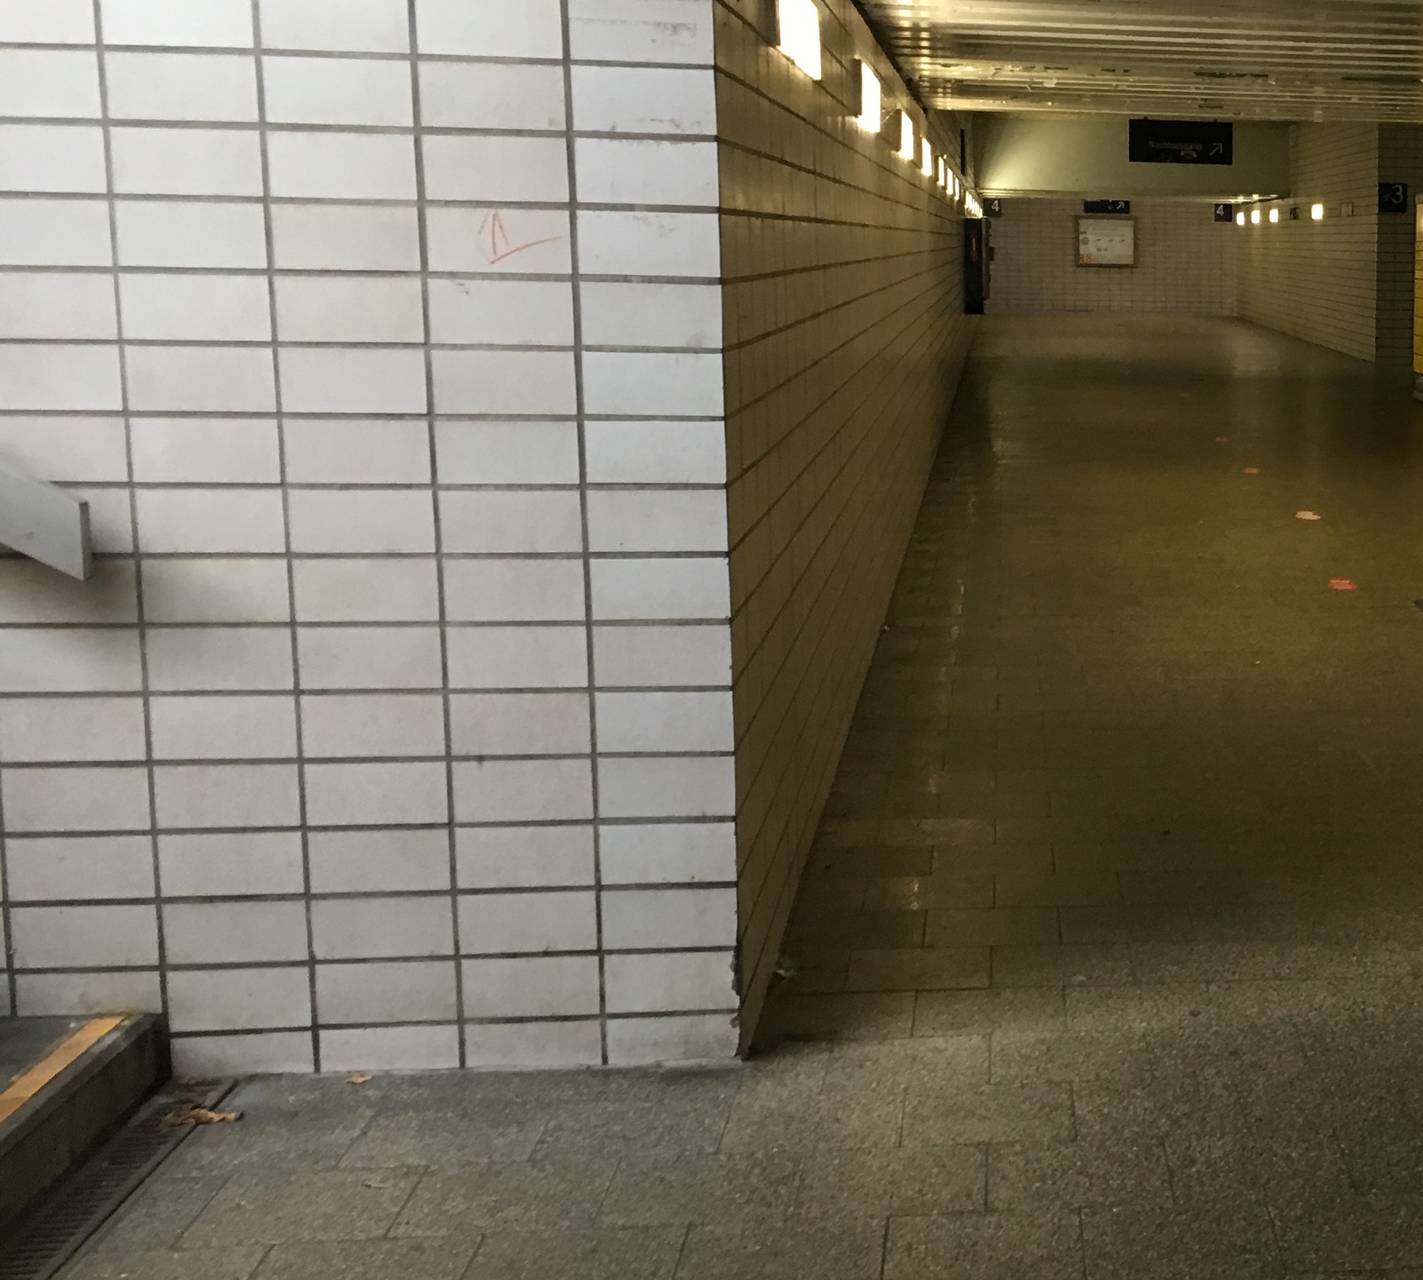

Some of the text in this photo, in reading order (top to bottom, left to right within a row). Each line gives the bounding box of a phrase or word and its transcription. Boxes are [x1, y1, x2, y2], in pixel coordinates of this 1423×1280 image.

[1391, 184, 1404, 204] 3
[991, 199, 1000, 212] 4
[1216, 204, 1225, 217] 4
